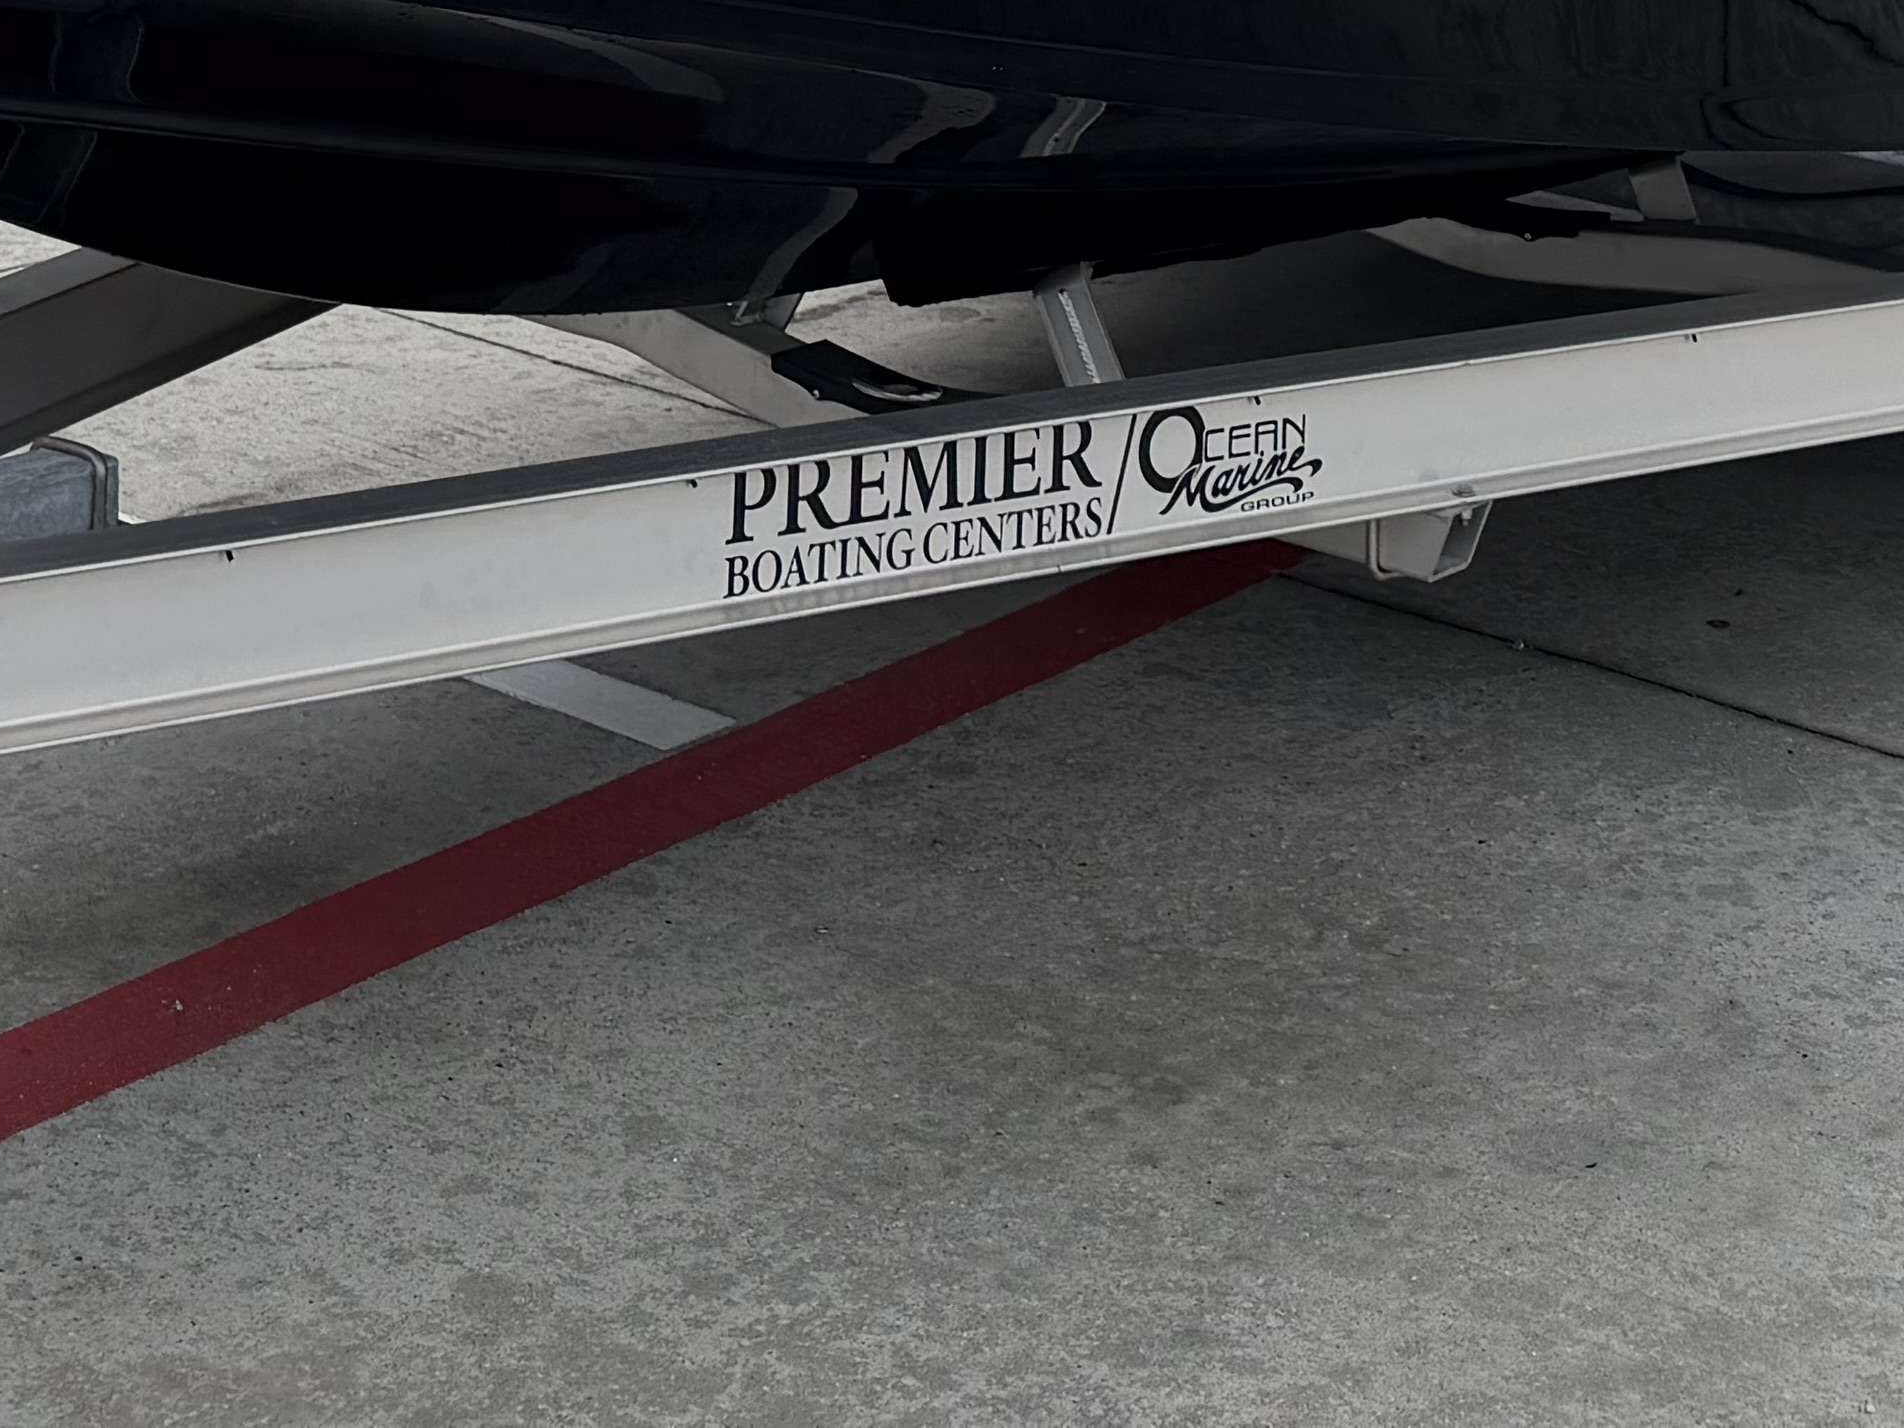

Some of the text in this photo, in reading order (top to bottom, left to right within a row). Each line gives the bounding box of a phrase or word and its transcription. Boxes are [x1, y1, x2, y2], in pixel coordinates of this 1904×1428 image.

[725, 421, 1102, 545] PREMIER
[1139, 405, 1306, 494] OCEAN
[1159, 445, 1323, 515] Marine
[1240, 490, 1315, 513] GROUP
[723, 496, 1103, 599] BOATING CENTERS
